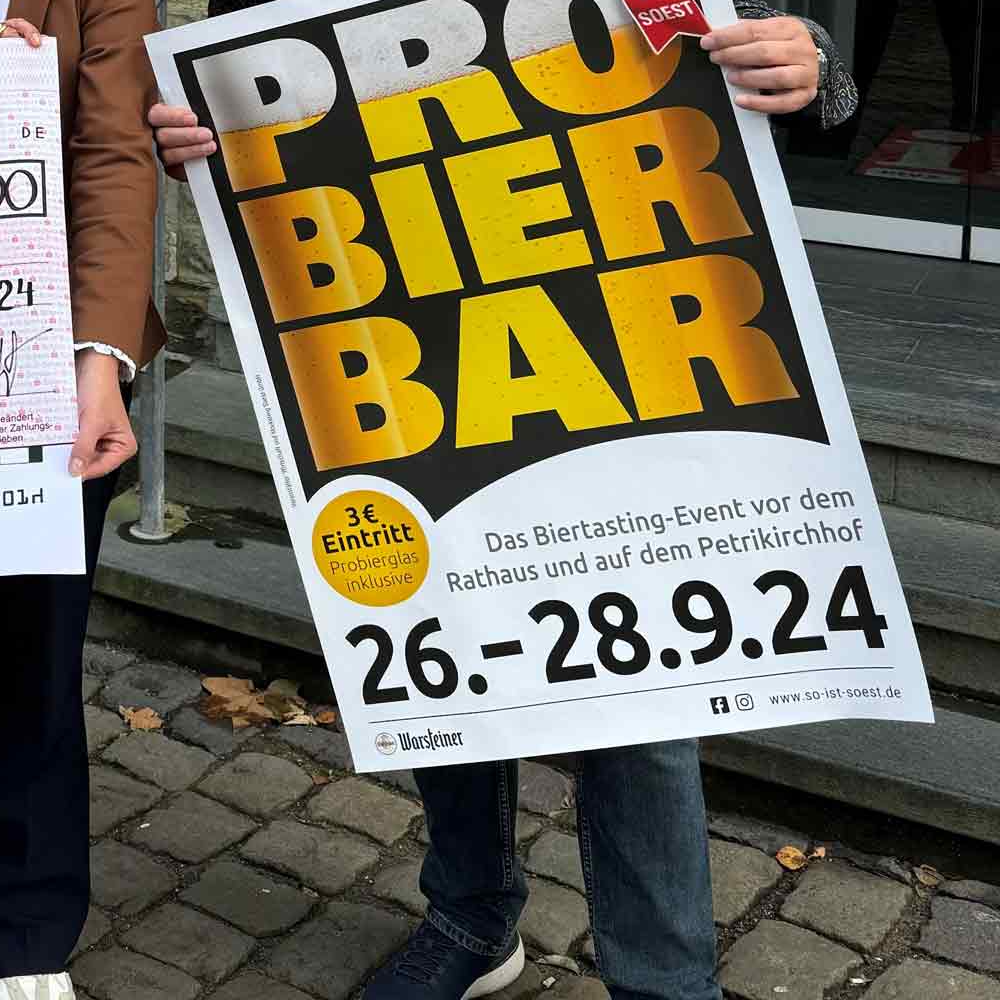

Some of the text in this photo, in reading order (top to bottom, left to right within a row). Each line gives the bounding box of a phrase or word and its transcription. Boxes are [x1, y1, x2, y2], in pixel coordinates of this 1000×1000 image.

[637, 0, 695, 27] SOEST
[237, 106, 753, 324] BIER
[278, 254, 800, 472] BAR
[10, 421, 54, 433] Zahlungs-
[485, 488, 855, 553] Das Biertasting-Event vor dem
[322, 523, 415, 554] Eintritt
[330, 549, 419, 575] Probierglas
[447, 518, 864, 593] Rathaus und auf dem Petrikirchhof
[346, 572, 413, 593] inklusive
[769, 685, 902, 706] www.so-ist-soest.de
[398, 728, 464, 751] Warsteiner
